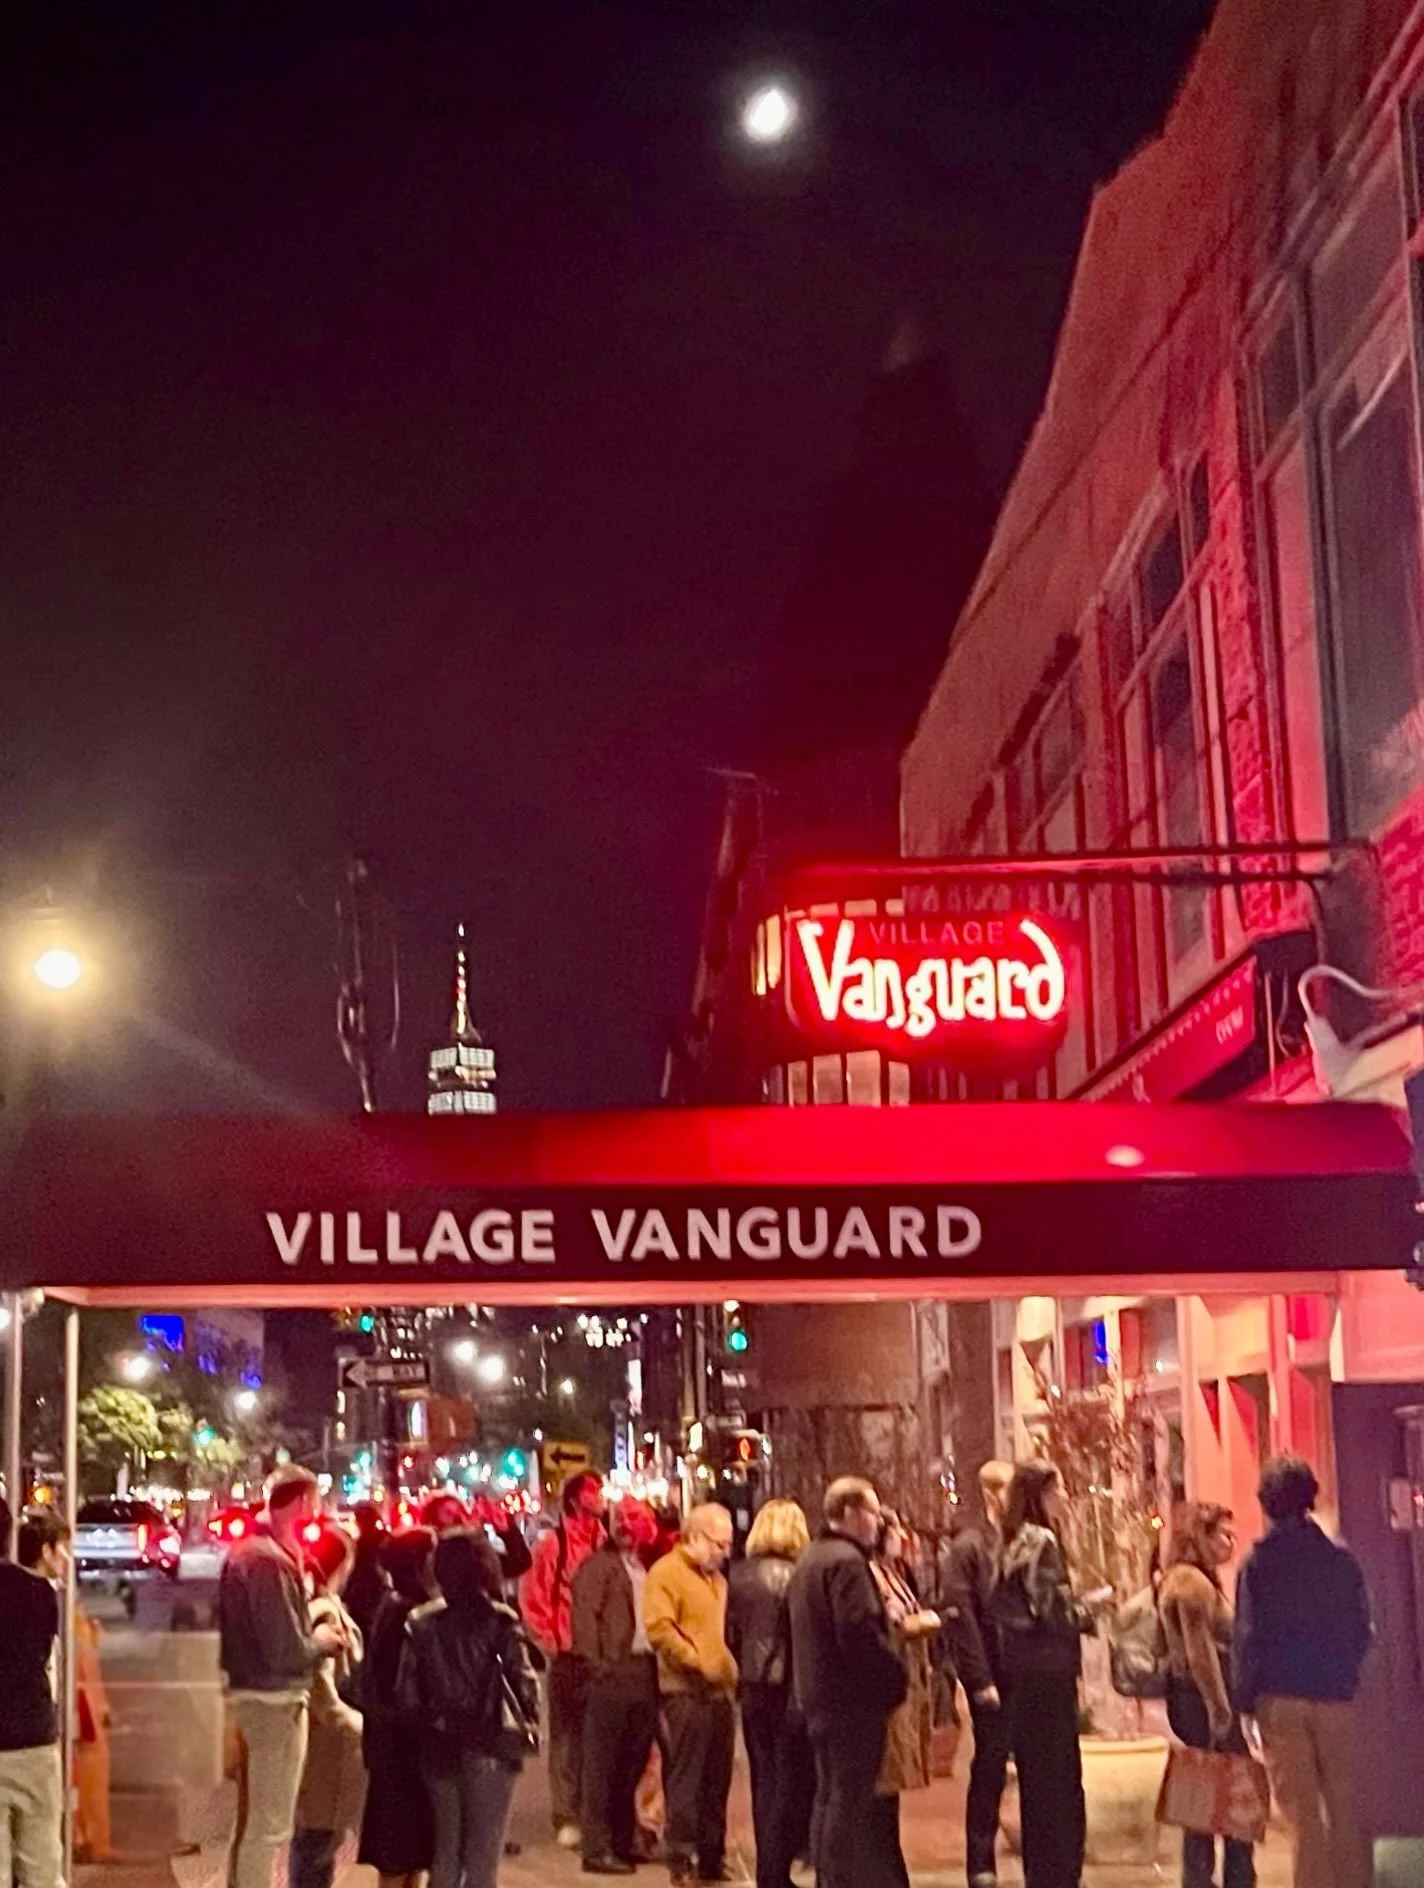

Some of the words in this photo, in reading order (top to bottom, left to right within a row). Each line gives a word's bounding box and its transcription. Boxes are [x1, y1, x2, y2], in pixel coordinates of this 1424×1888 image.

[869, 920, 1005, 946] VILLAGE
[796, 918, 1065, 1037] Vanguard
[265, 1208, 556, 1265] VILLAGE
[590, 1205, 983, 1262] VANGUARD
